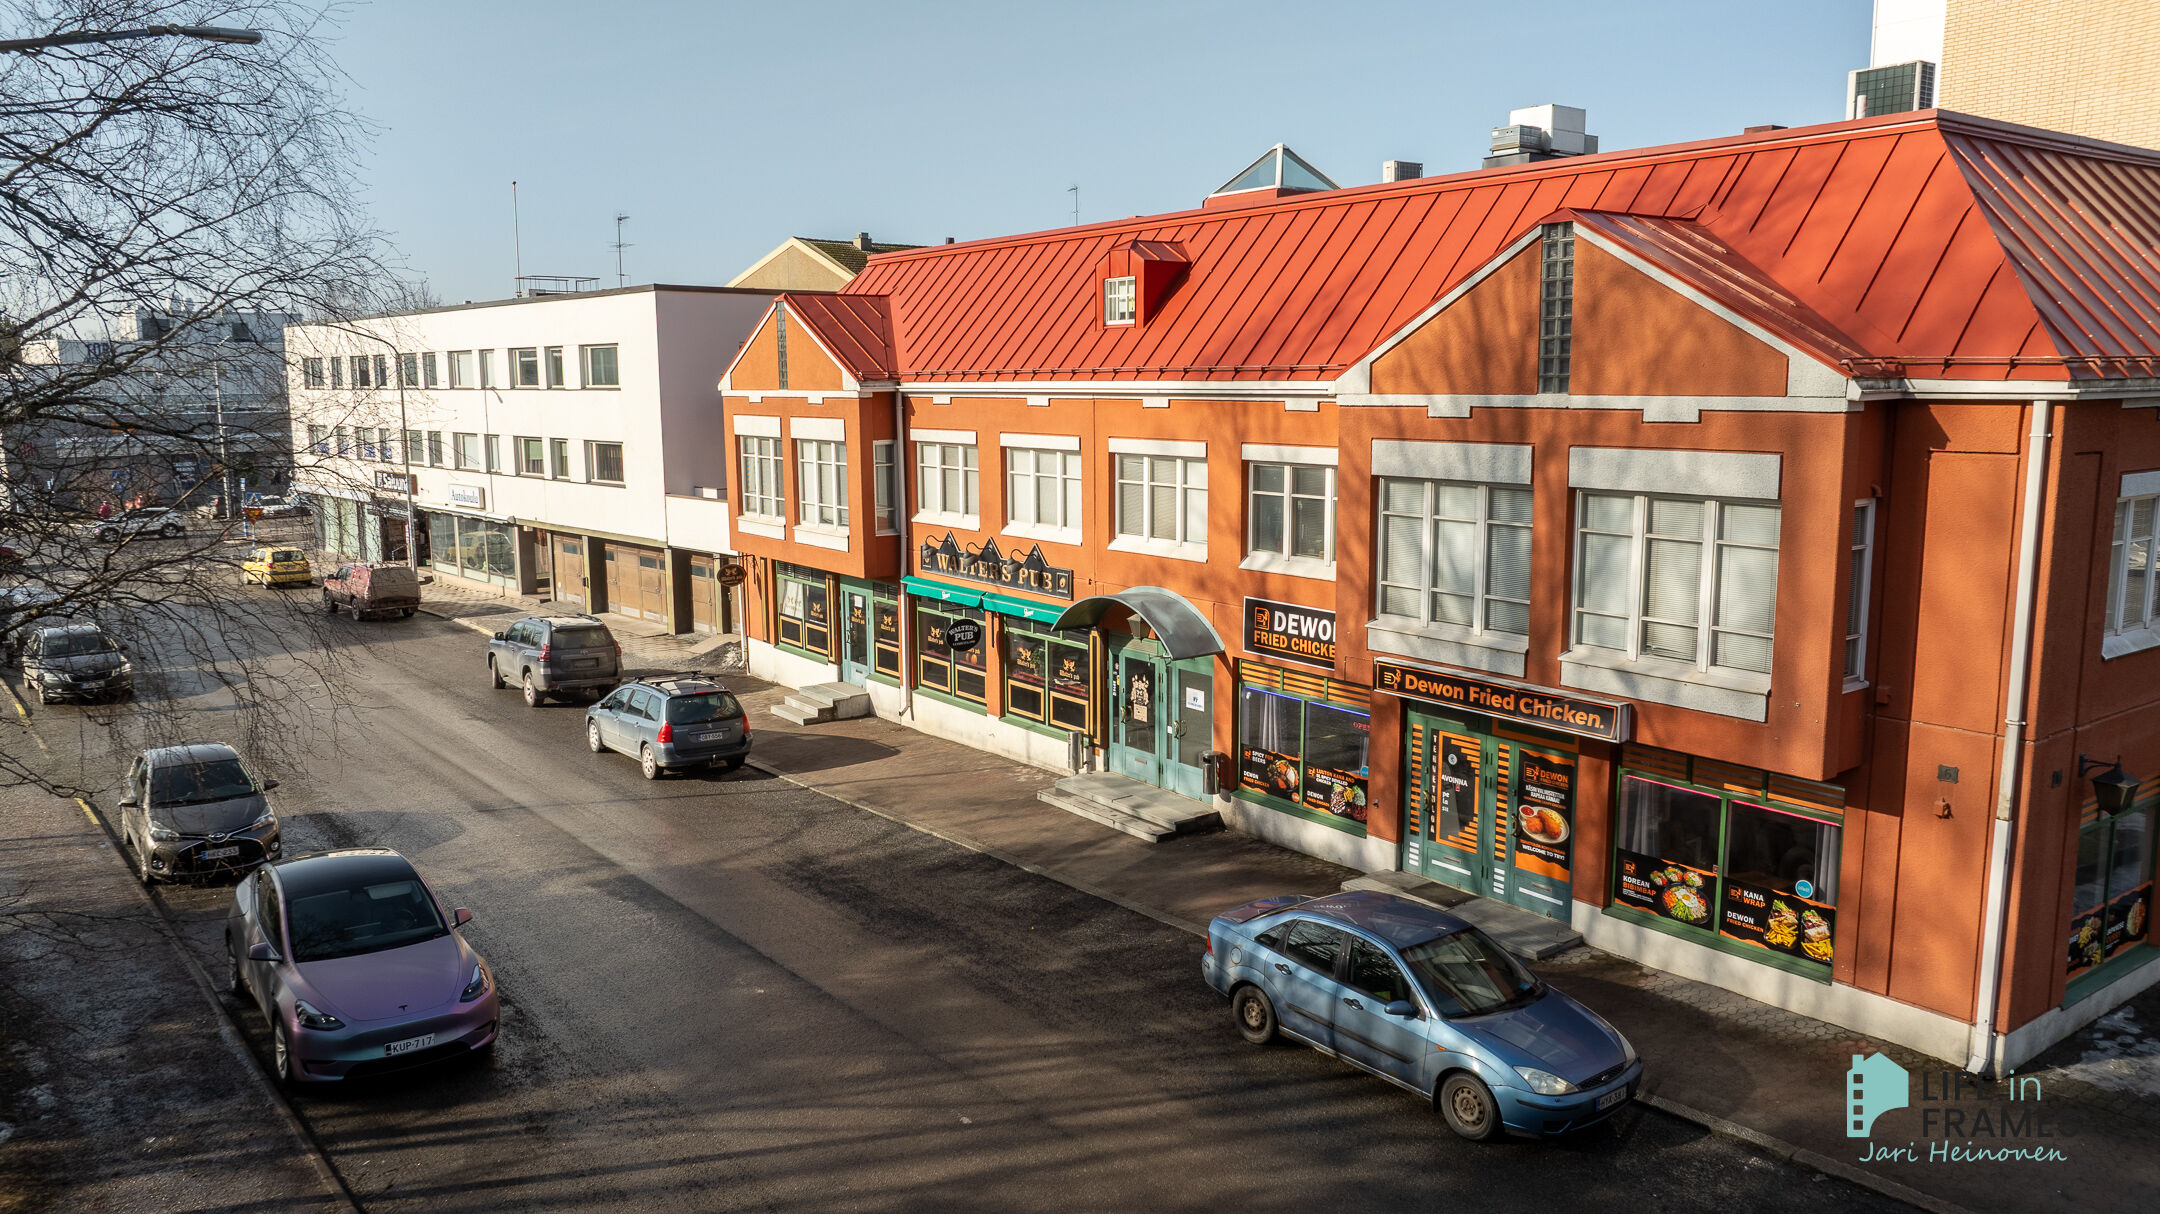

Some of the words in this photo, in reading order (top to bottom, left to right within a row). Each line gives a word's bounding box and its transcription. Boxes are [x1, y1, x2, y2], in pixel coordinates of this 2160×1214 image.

[1018, 567, 1053, 592] PUB
[948, 624, 979, 636] WALTER'S
[1274, 610, 1336, 643] DEWO
[954, 631, 974, 642] PUB
[1254, 630, 1288, 648] FRIED
[1291, 638, 1336, 658] CHICKE
[1405, 673, 1464, 700] Dewon
[1469, 686, 1515, 711] Fried
[1519, 697, 1605, 729] Chicken.
[1442, 774, 1468, 787] AVOINNA
[1540, 770, 1569, 783] DEWON
[1521, 843, 1546, 855] WELCOME
[1622, 881, 1657, 896] BIBIMBAP
[1623, 875, 1650, 888] KOREAN
[1742, 896, 1766, 909] WRAP
[1743, 889, 1765, 902] KANA
[1726, 910, 1755, 925] DEWON
[1726, 917, 1741, 927] FRIED
[1741, 921, 1765, 933] CHICKEN
[393, 1036, 432, 1053] KUP-717
